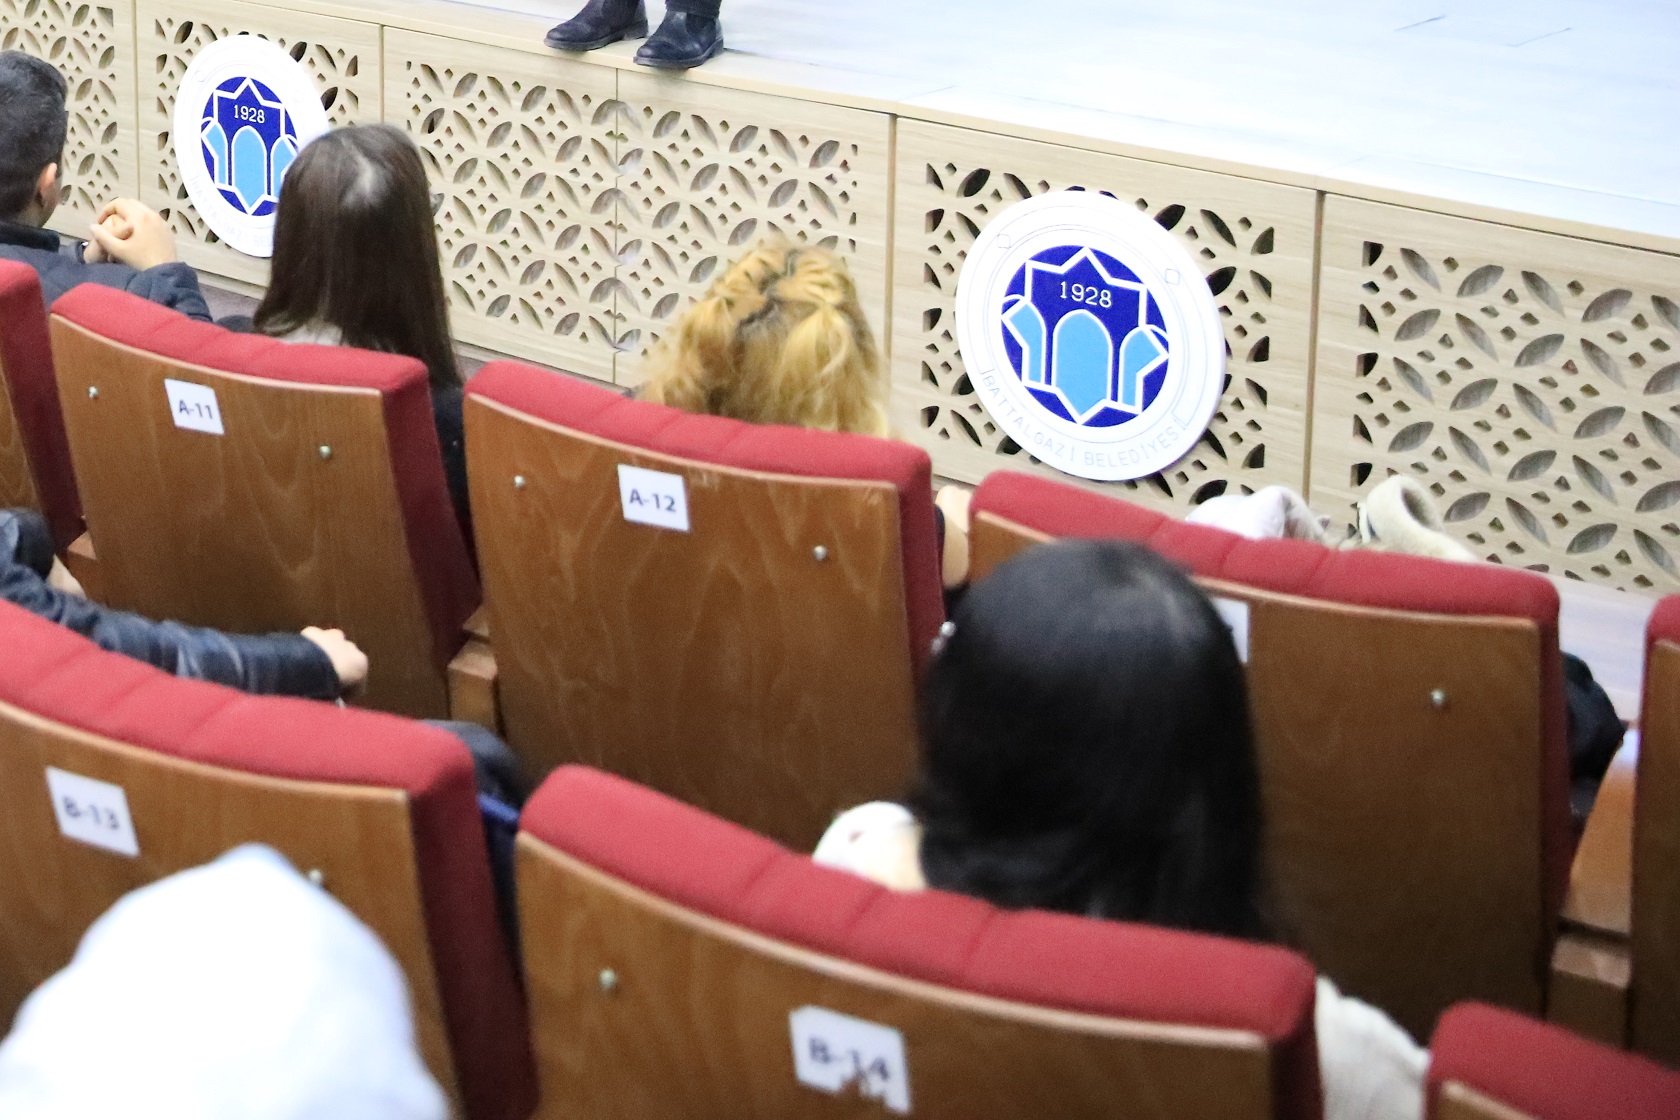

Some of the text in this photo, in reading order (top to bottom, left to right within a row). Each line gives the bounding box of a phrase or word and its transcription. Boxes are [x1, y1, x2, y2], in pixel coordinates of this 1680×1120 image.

[233, 104, 265, 124] 1928
[1059, 280, 1113, 308] 1928
[178, 399, 213, 420] A-11
[629, 488, 677, 513] A-12
[62, 795, 120, 831] B-13
